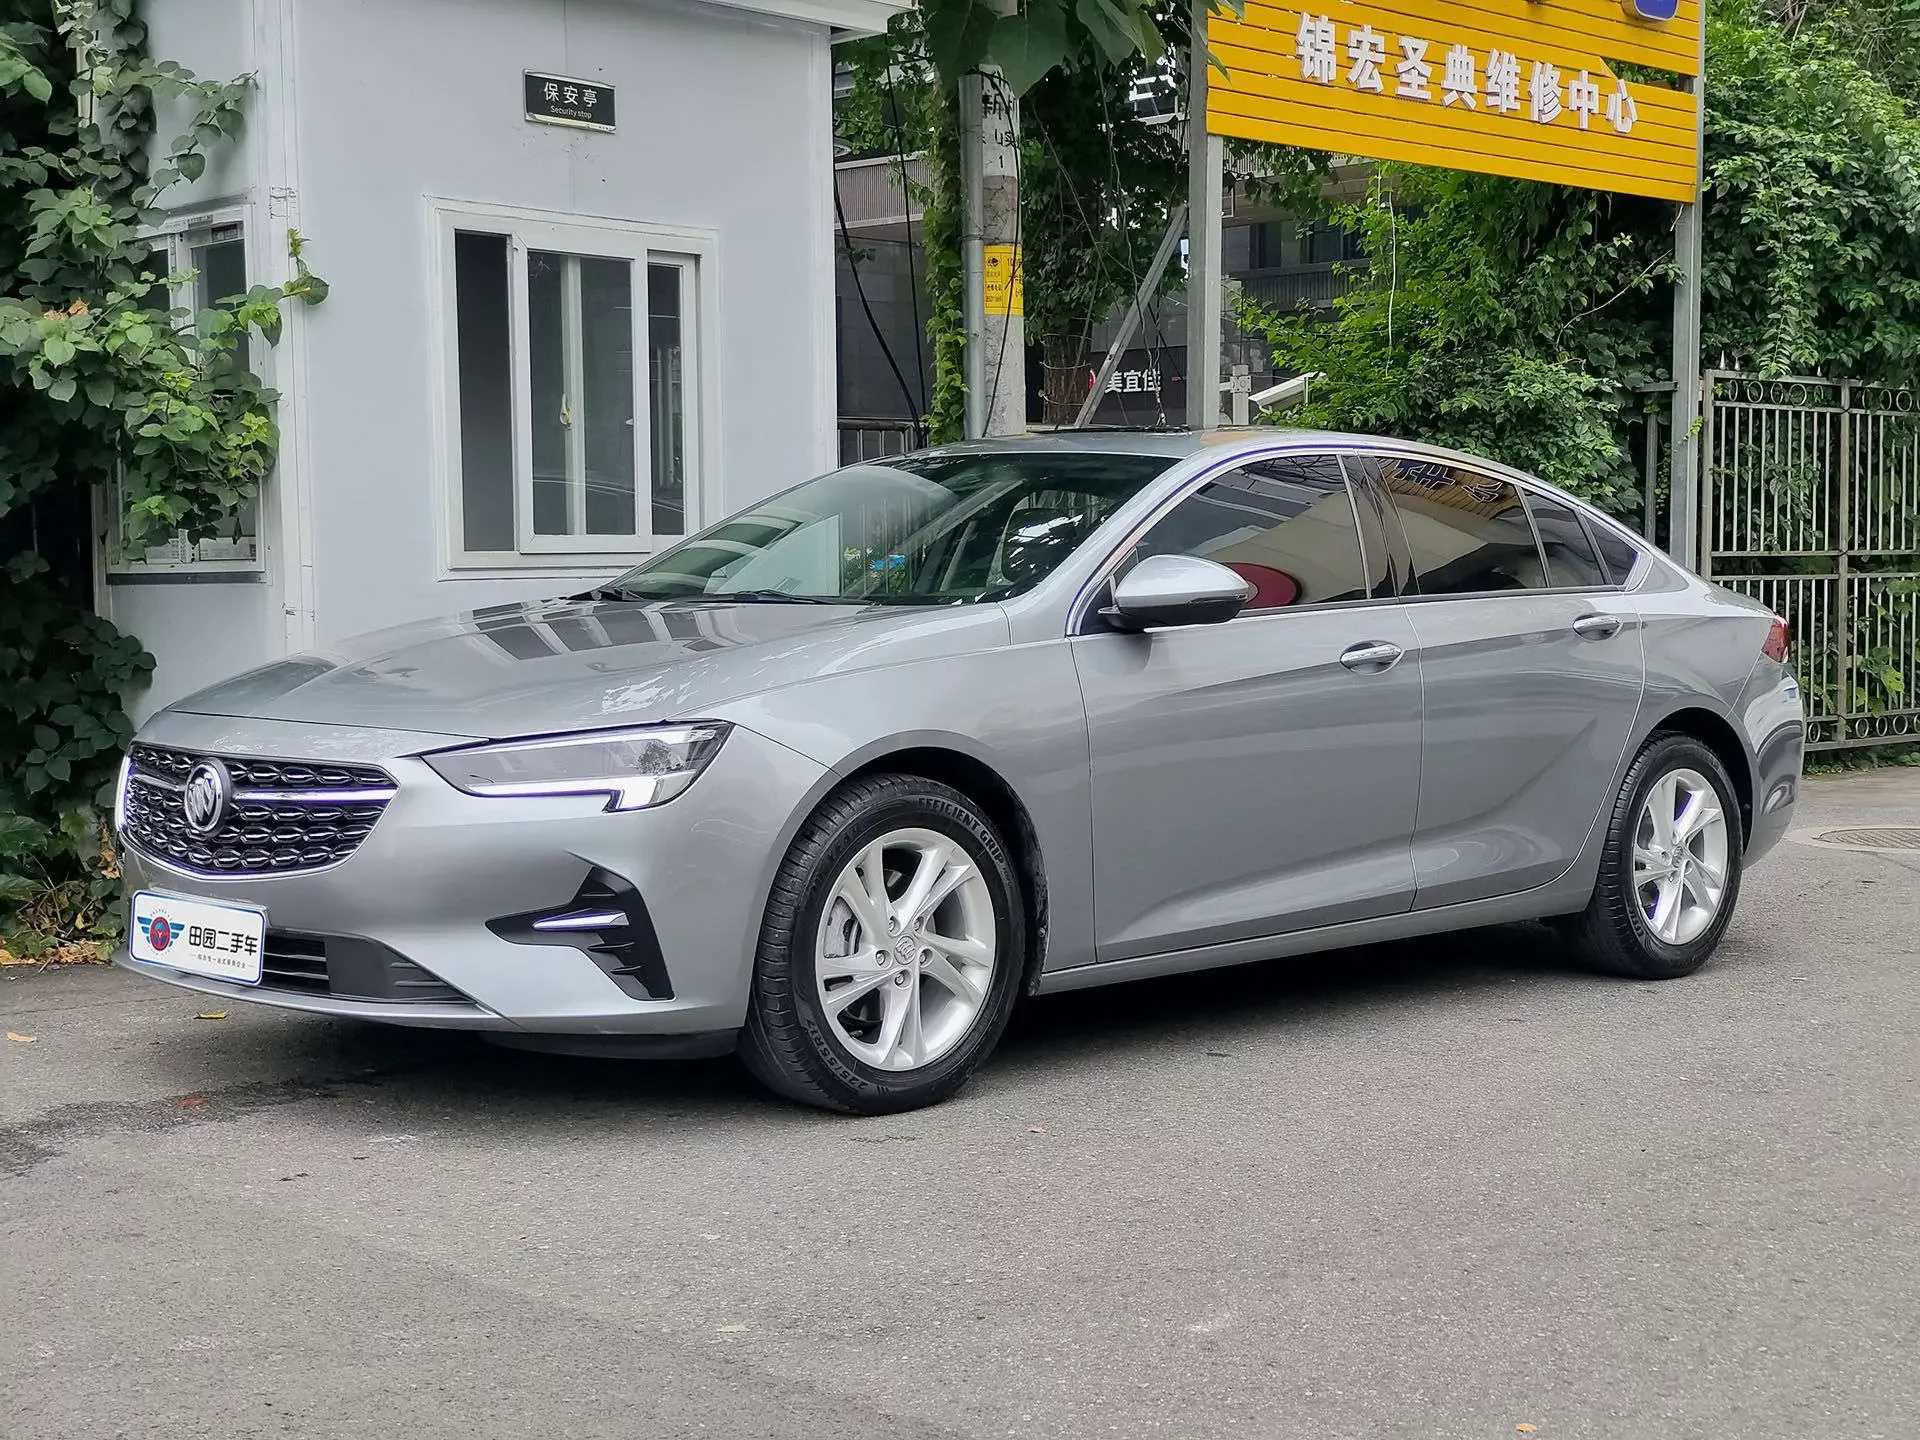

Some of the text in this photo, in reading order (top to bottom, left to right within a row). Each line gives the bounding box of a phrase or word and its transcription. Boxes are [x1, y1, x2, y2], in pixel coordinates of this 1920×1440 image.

[1295, 11, 1637, 134] 锦宏圣典维修中心
[543, 81, 598, 107] 保安亭
[550, 104, 592, 119] Security stop
[1104, 368, 1161, 394] 美宜佳
[189, 925, 258, 956] 田园二手车
